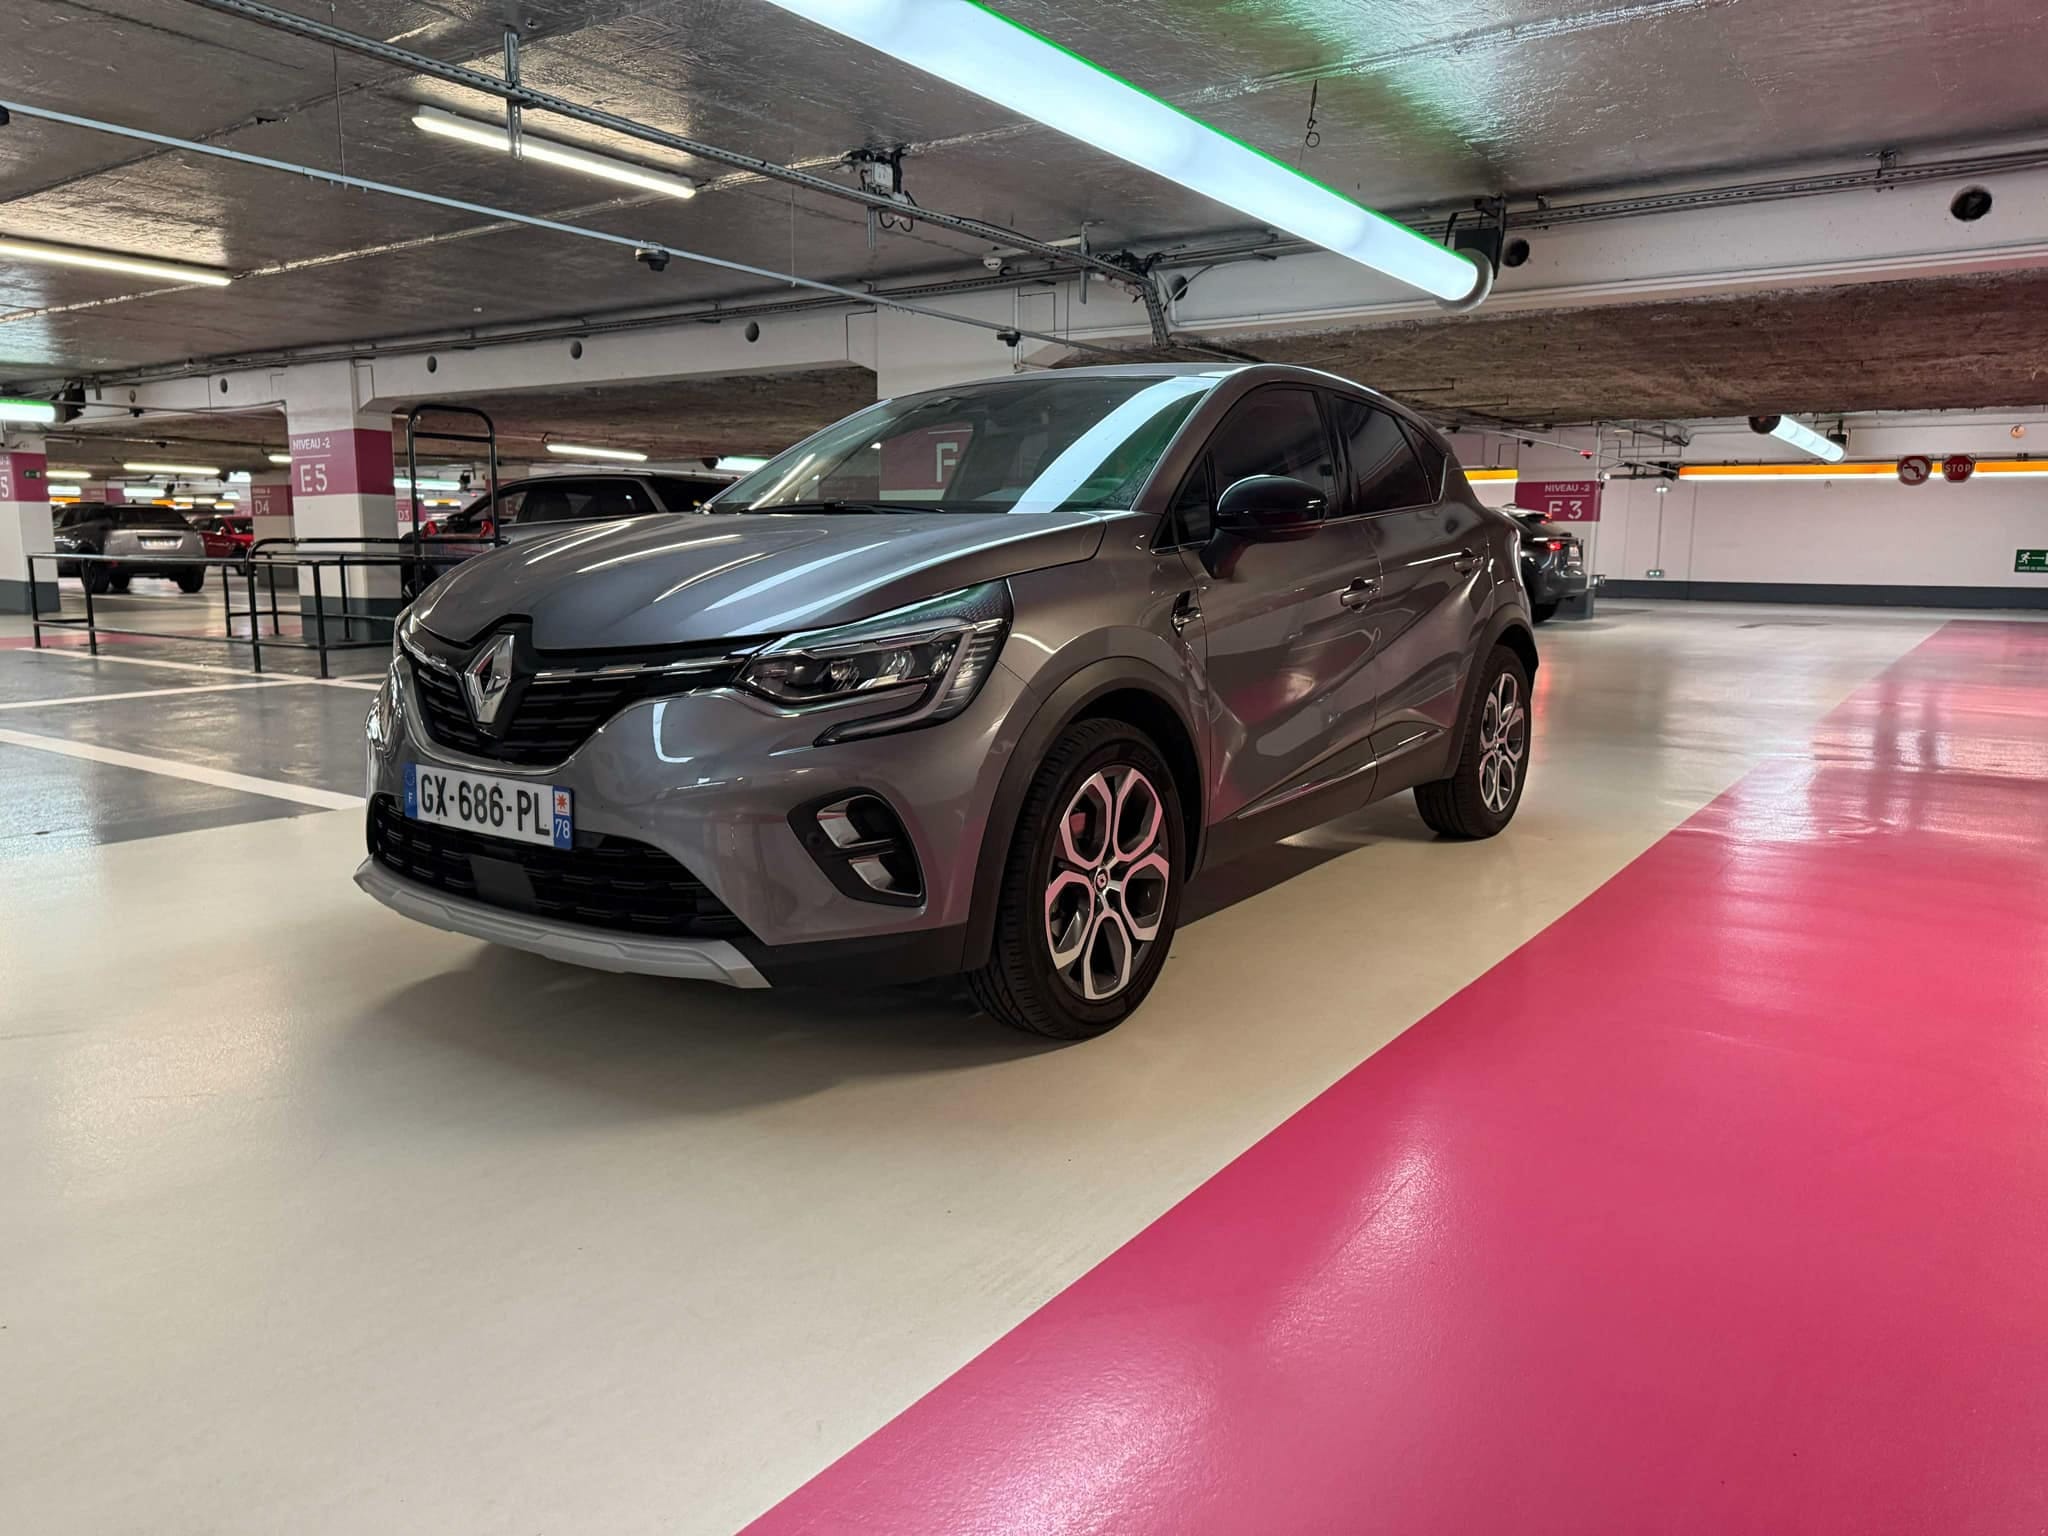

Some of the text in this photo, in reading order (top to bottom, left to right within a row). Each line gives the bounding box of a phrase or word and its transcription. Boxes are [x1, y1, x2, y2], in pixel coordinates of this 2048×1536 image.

[292, 437, 331, 451] NIVEAU -2
[1944, 463, 1971, 474] STOP
[299, 463, 328, 493] E5
[1544, 483, 1591, 493] NIVEAU -2
[254, 499, 270, 515] D4
[408, 773, 571, 839] F GX-686-PL 78
